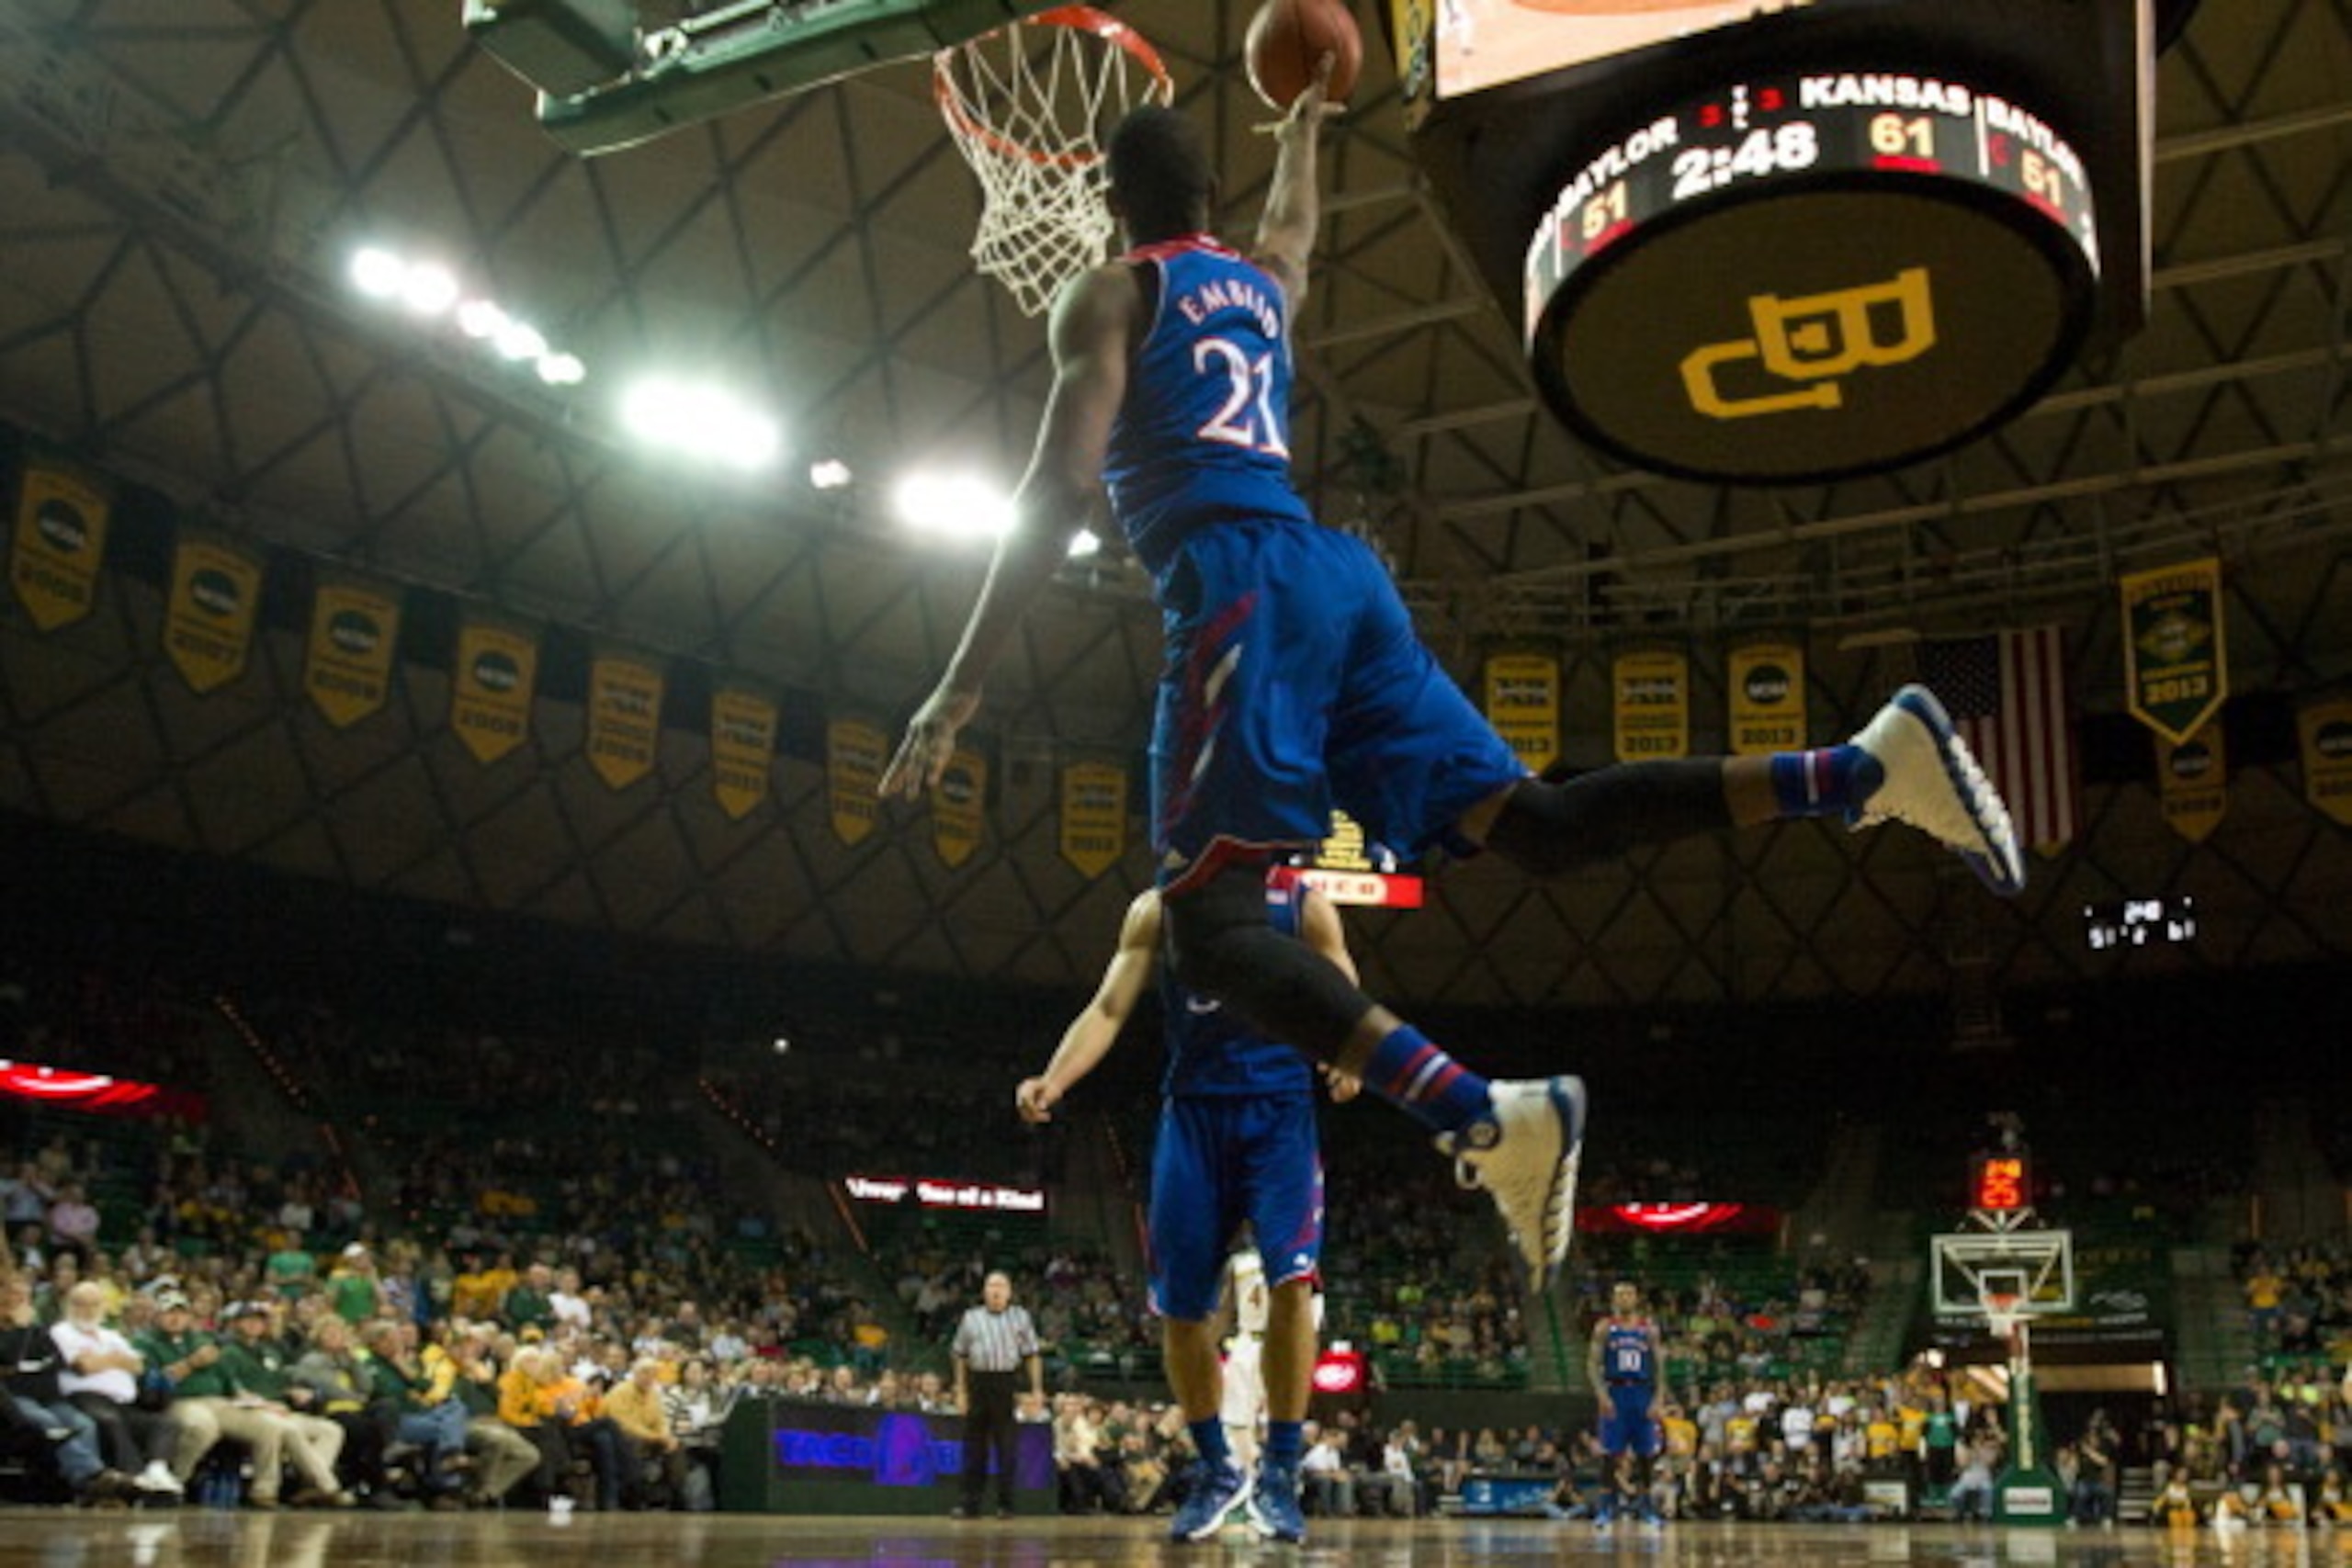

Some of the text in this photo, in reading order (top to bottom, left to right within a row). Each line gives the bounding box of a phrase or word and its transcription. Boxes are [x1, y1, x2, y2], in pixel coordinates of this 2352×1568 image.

[1799, 73, 1971, 117] KANSAS
[1670, 120, 1818, 200] 2:48
[1870, 112, 1933, 158] 61
[2022, 149, 2061, 208] 51
[1582, 179, 1625, 239] 51
[1178, 279, 1281, 340] EMBIID
[1193, 336, 1291, 461] 21
[1623, 736, 1679, 753] 2013
[1741, 728, 1795, 746] 2013
